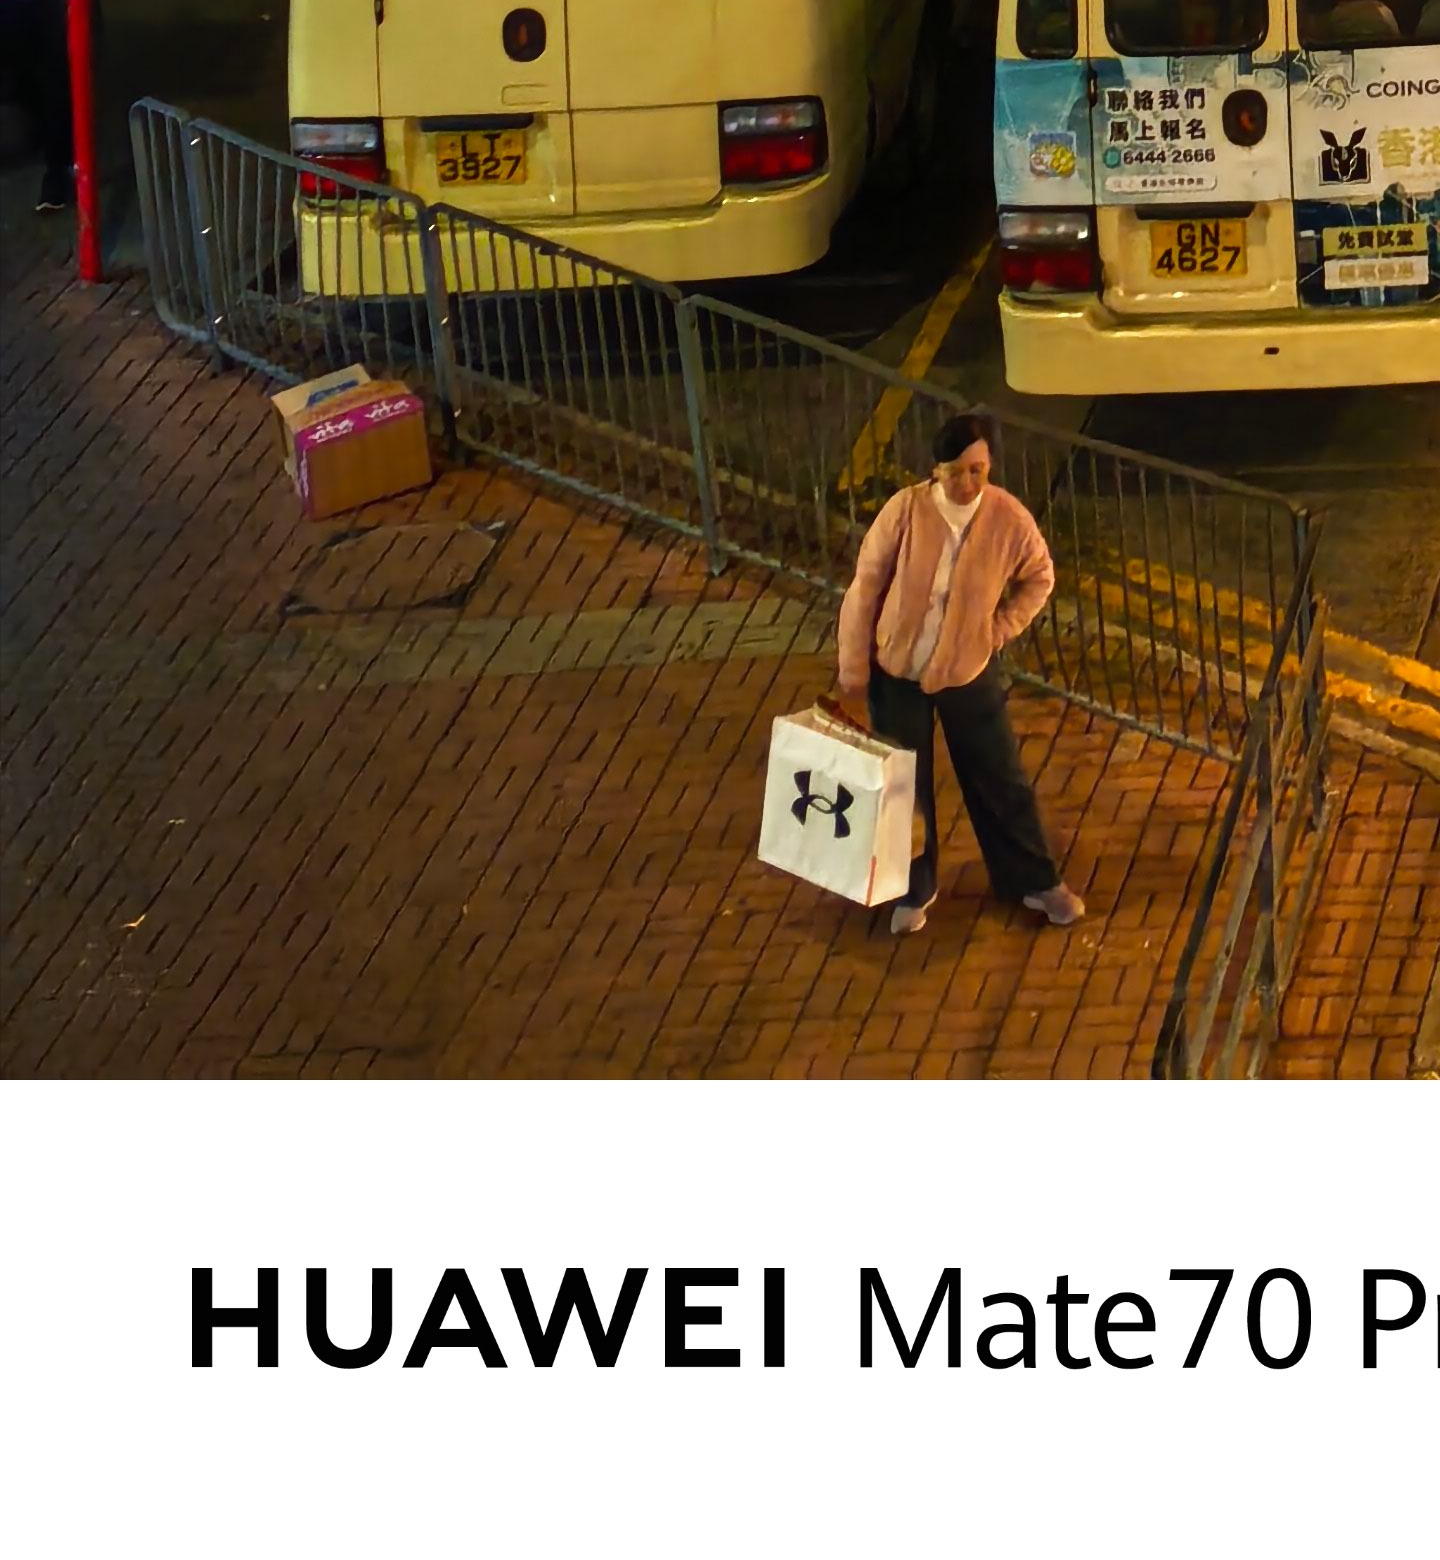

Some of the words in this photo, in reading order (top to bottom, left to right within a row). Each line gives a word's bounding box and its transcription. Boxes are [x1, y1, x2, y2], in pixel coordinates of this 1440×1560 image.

[1107, 88, 1206, 110] 聯絡我們
[460, 134, 500, 159] LT
[1123, 149, 1166, 164] 6444
[441, 154, 523, 181] 3927
[1177, 223, 1220, 247] GN
[1156, 246, 1241, 272] 4627
